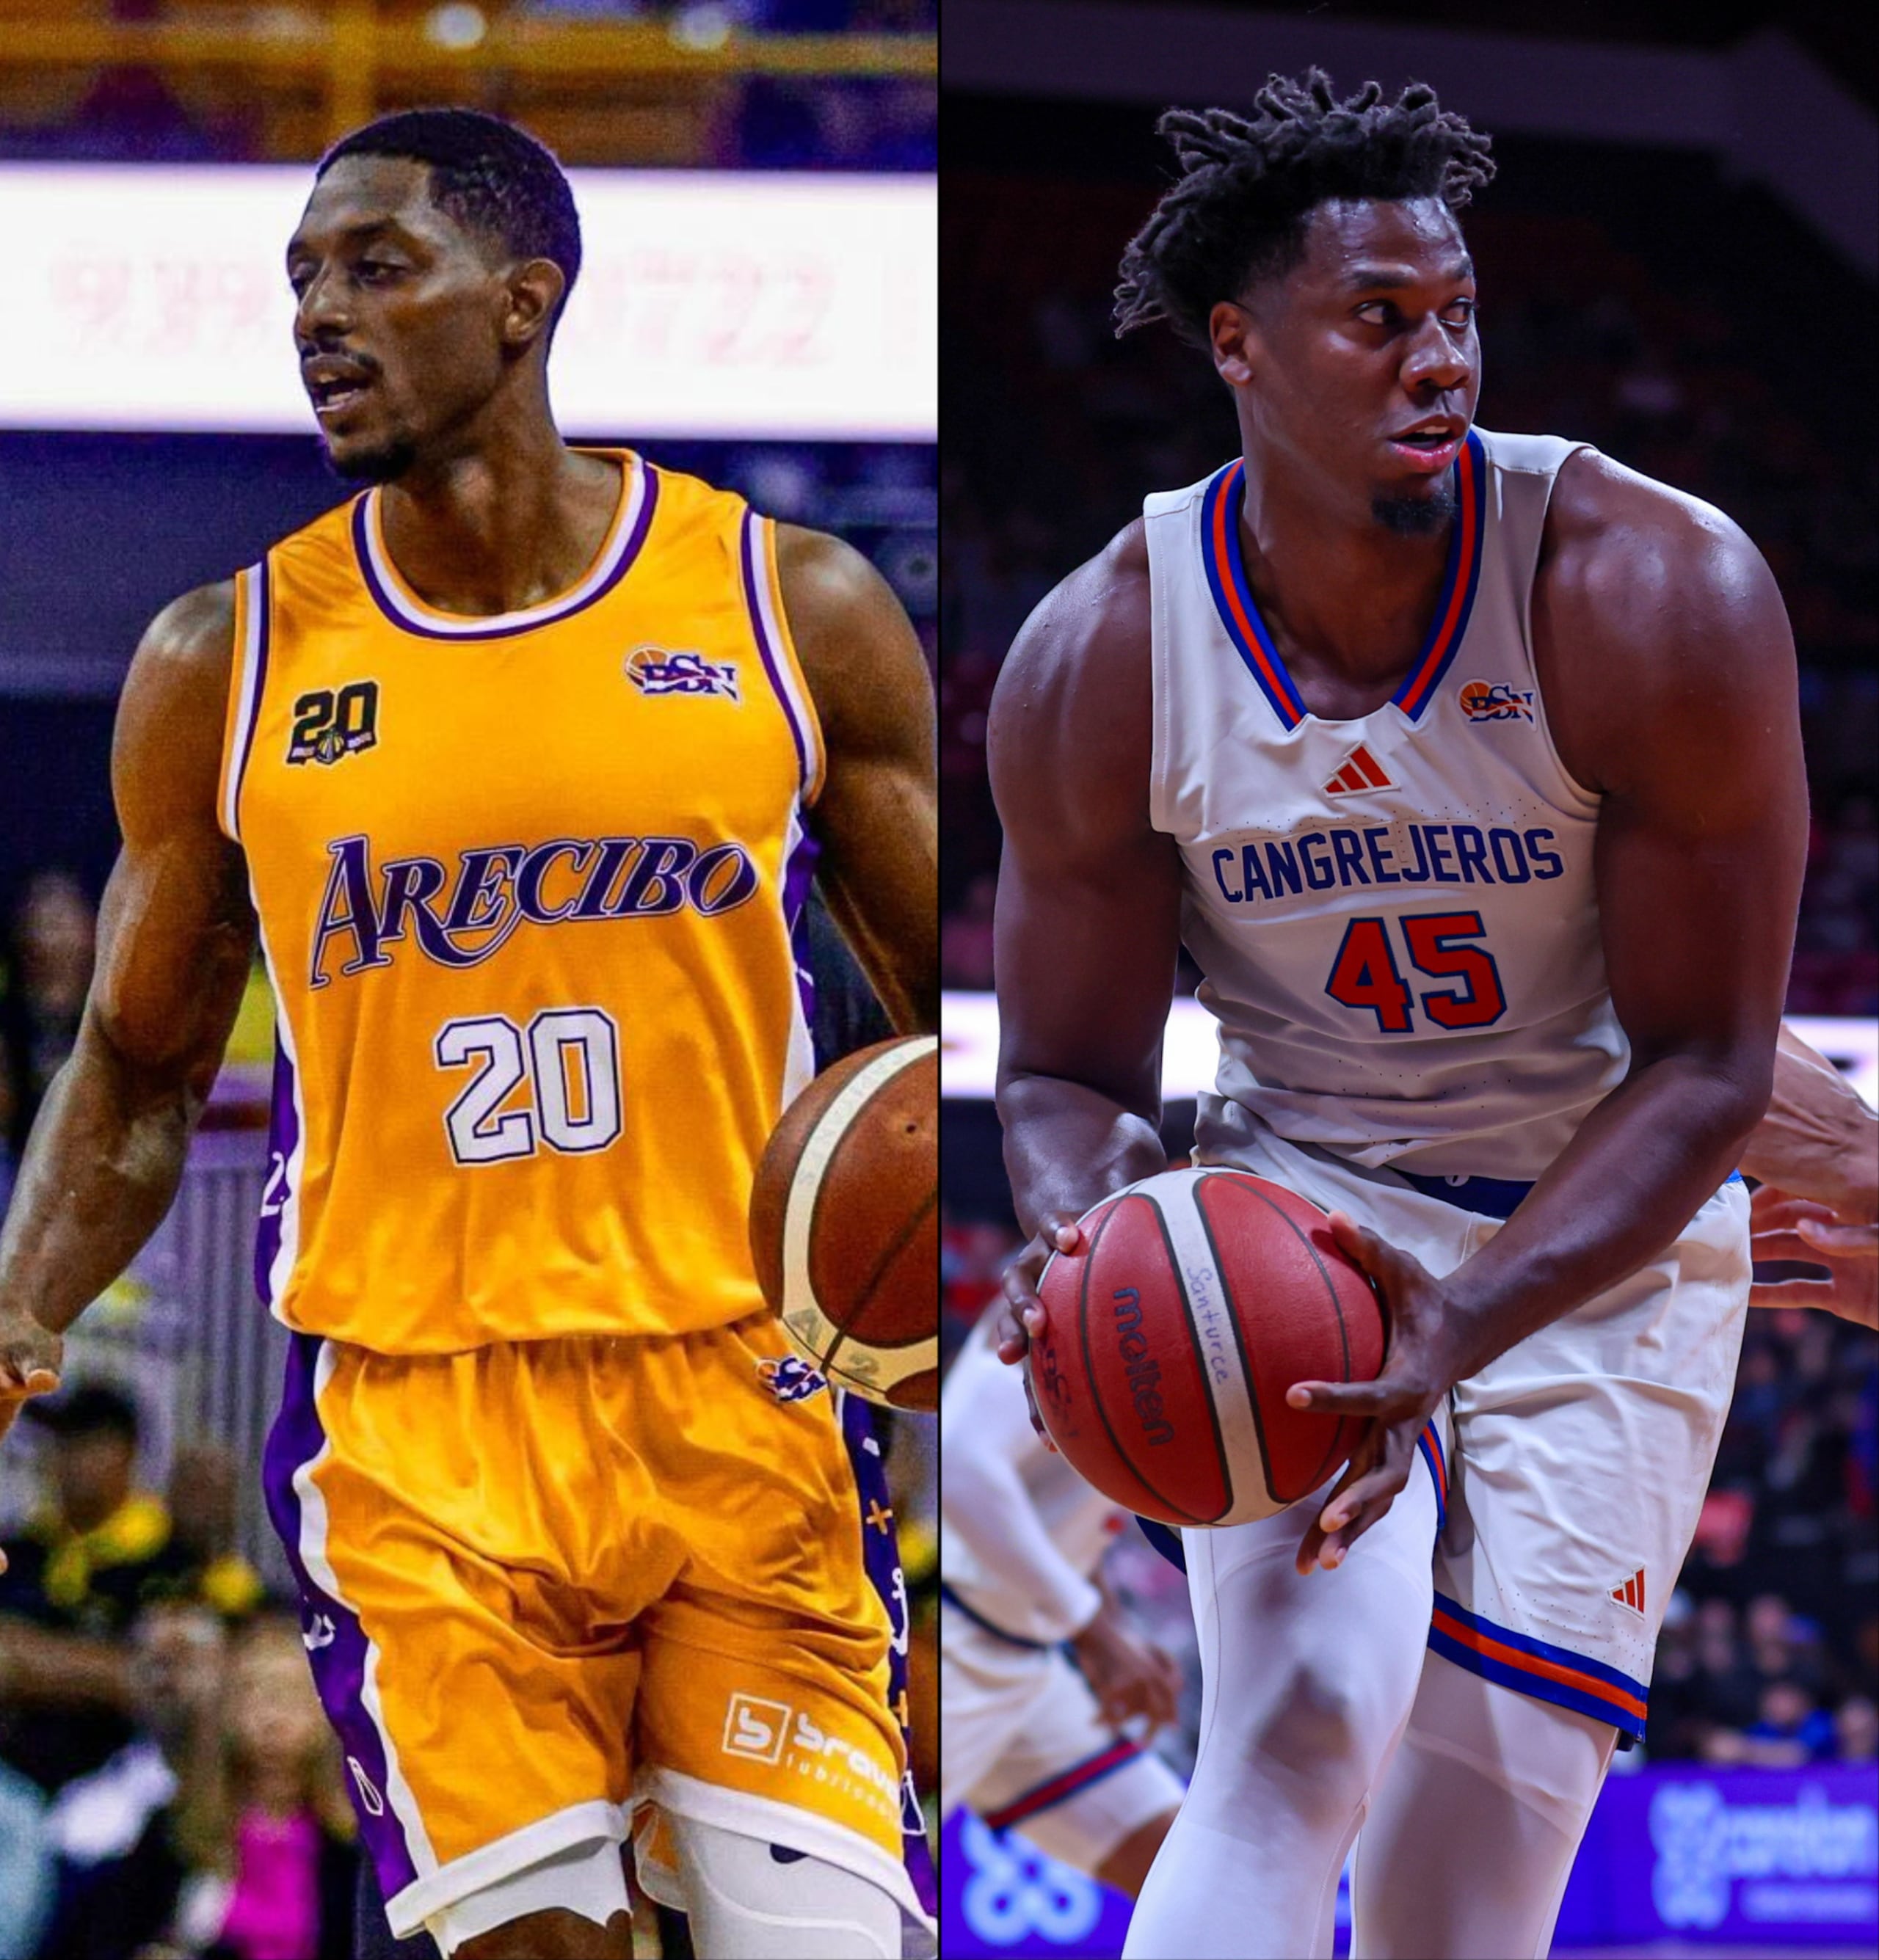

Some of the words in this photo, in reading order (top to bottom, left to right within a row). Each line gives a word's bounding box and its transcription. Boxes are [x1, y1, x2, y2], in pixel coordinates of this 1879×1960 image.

[286, 680, 379, 765] 20
[639, 654, 738, 701] BSN
[1469, 685, 1533, 724] BSN
[1210, 824, 1564, 903] CANGREJEROS
[1323, 910, 1508, 1034] 45
[435, 1006, 624, 1165] 20
[1113, 1286, 1174, 1447] molten
[1186, 1266, 1228, 1385] Santurce
